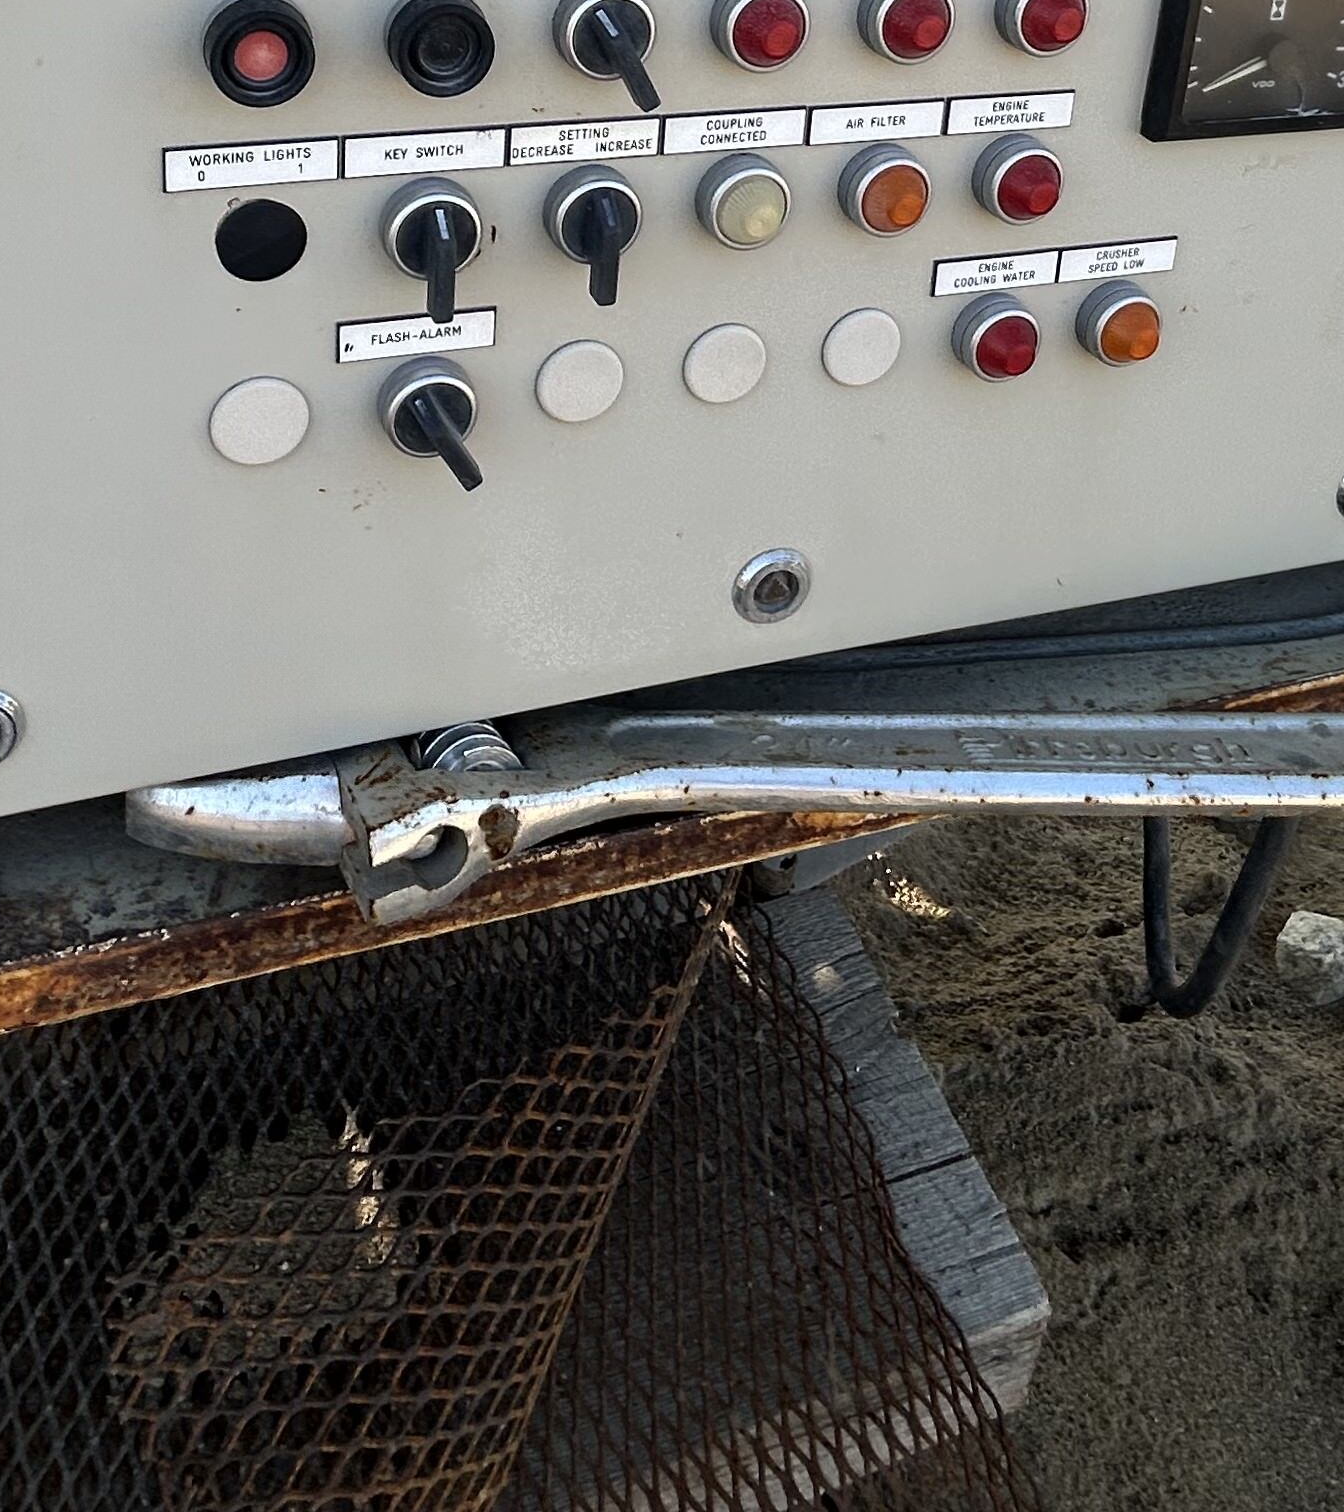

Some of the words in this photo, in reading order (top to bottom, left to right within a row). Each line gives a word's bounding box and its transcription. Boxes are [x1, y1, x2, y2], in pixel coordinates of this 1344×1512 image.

[992, 100, 1030, 112] ENGINE
[706, 116, 763, 131] COUPLING
[845, 117, 864, 130] AIR
[870, 114, 906, 128] FILTER
[973, 112, 1045, 127] TEMPERATURE
[558, 127, 610, 141] SETTING
[700, 130, 767, 145] CONNECTED
[384, 148, 408, 161] KEY
[416, 144, 464, 158] SWITCH
[512, 144, 574, 159] DECREASE
[595, 138, 653, 153] INCREASE
[189, 150, 255, 167] WORKING
[263, 147, 312, 162] LIGHTS
[1096, 247, 1140, 261] CRUSHER
[978, 260, 1014, 273] ENGINE
[1088, 261, 1118, 274] SPEED
[1123, 258, 1145, 270] LOW
[953, 274, 997, 288] COOLING
[1002, 270, 1036, 283] WATER
[371, 325, 462, 346] FLASH-ALARM
